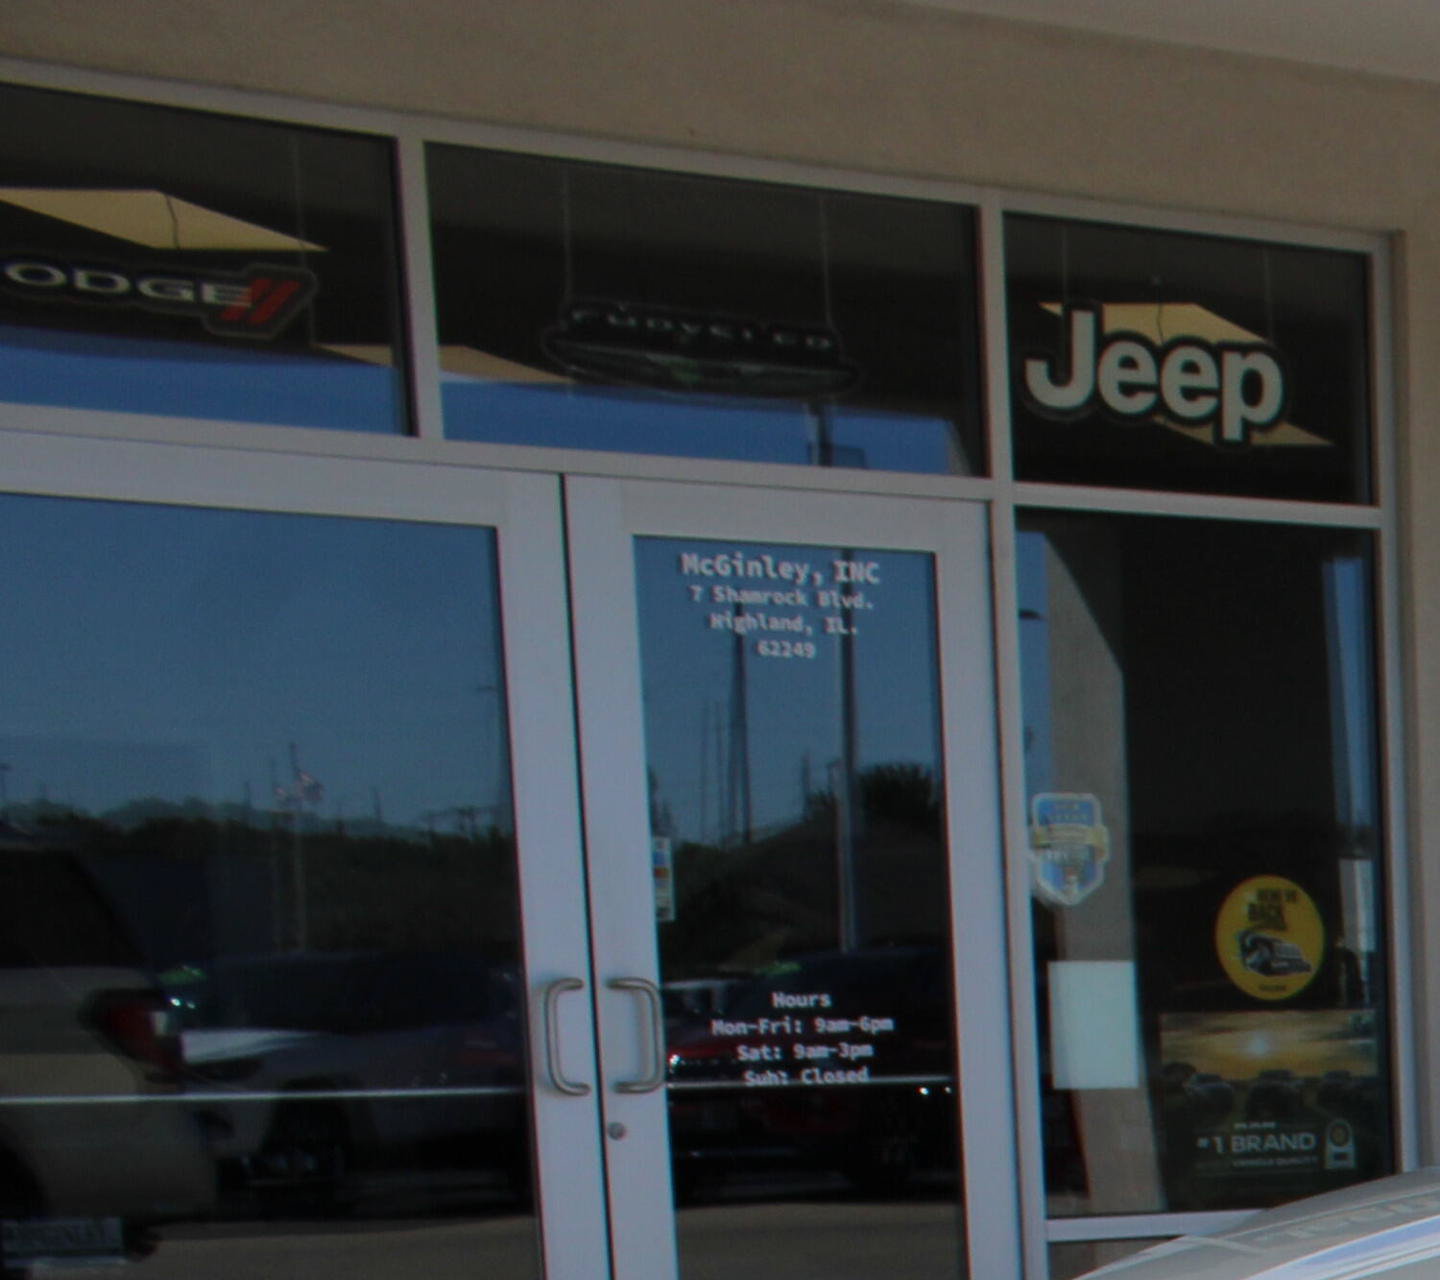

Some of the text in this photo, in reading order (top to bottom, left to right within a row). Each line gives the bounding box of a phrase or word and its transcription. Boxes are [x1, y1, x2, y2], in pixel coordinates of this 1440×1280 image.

[1024, 309, 1284, 442] Jeep
[681, 552, 881, 585] McGinley, INC
[710, 584, 809, 607] Shamrock
[817, 590, 874, 610] Blvd.
[709, 610, 813, 636] Highland,
[757, 640, 816, 659] 62249
[772, 991, 832, 1009] Hours
[711, 1015, 895, 1036] Mon-Fri: 9am-6pm
[737, 1042, 874, 1061] Sat: 9am-3pm
[801, 1066, 869, 1084] Closed
[1230, 1131, 1317, 1154] BRAND
